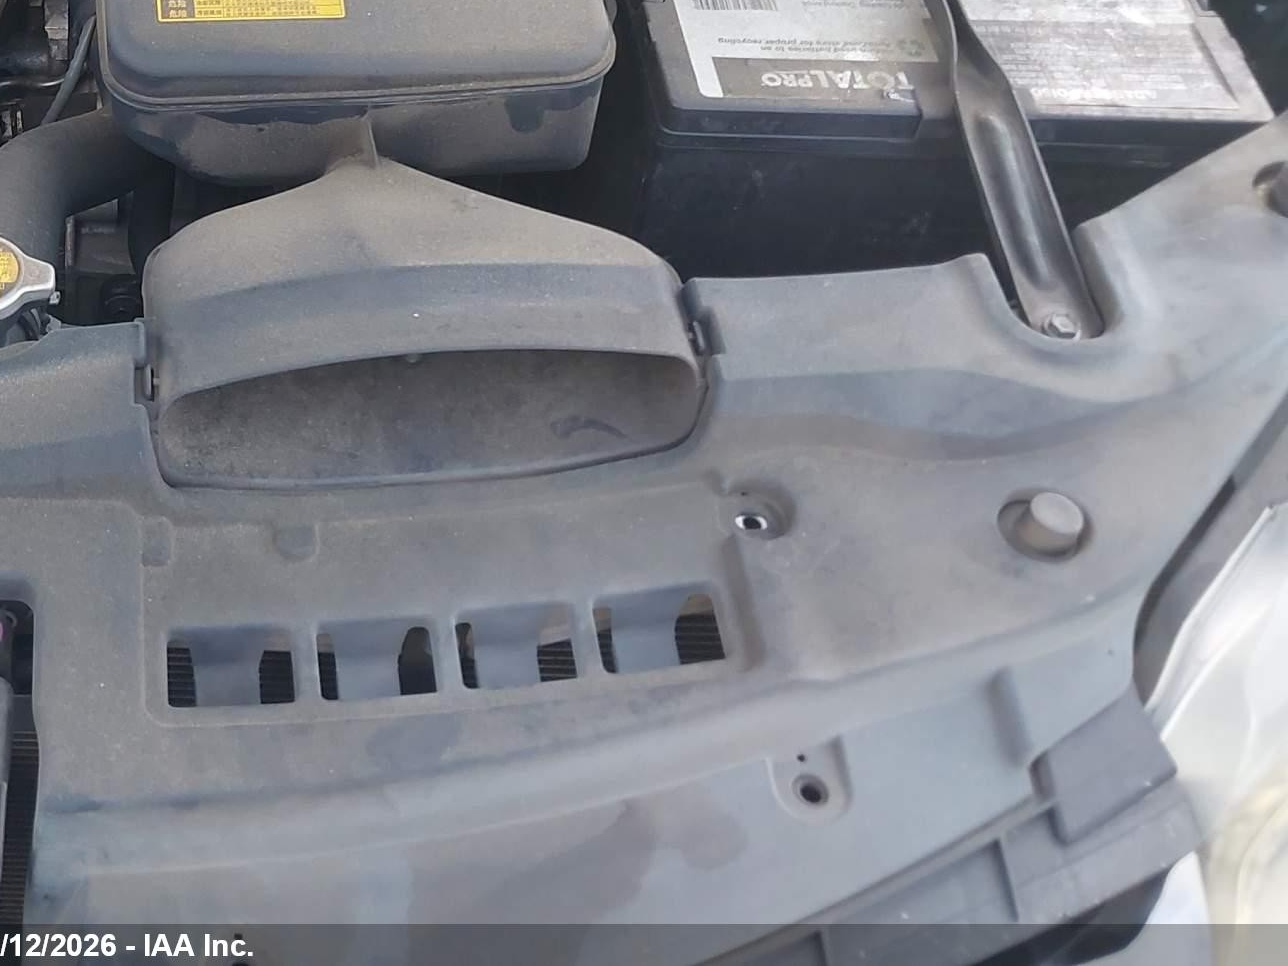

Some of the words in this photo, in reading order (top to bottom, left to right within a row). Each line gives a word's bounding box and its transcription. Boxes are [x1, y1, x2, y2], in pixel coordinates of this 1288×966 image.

[717, 37, 763, 45] recycling
[764, 37, 796, 46] proper
[798, 38, 813, 47] for
[788, 45, 831, 53] batteries
[761, 70, 915, 90] TOTALPRO
